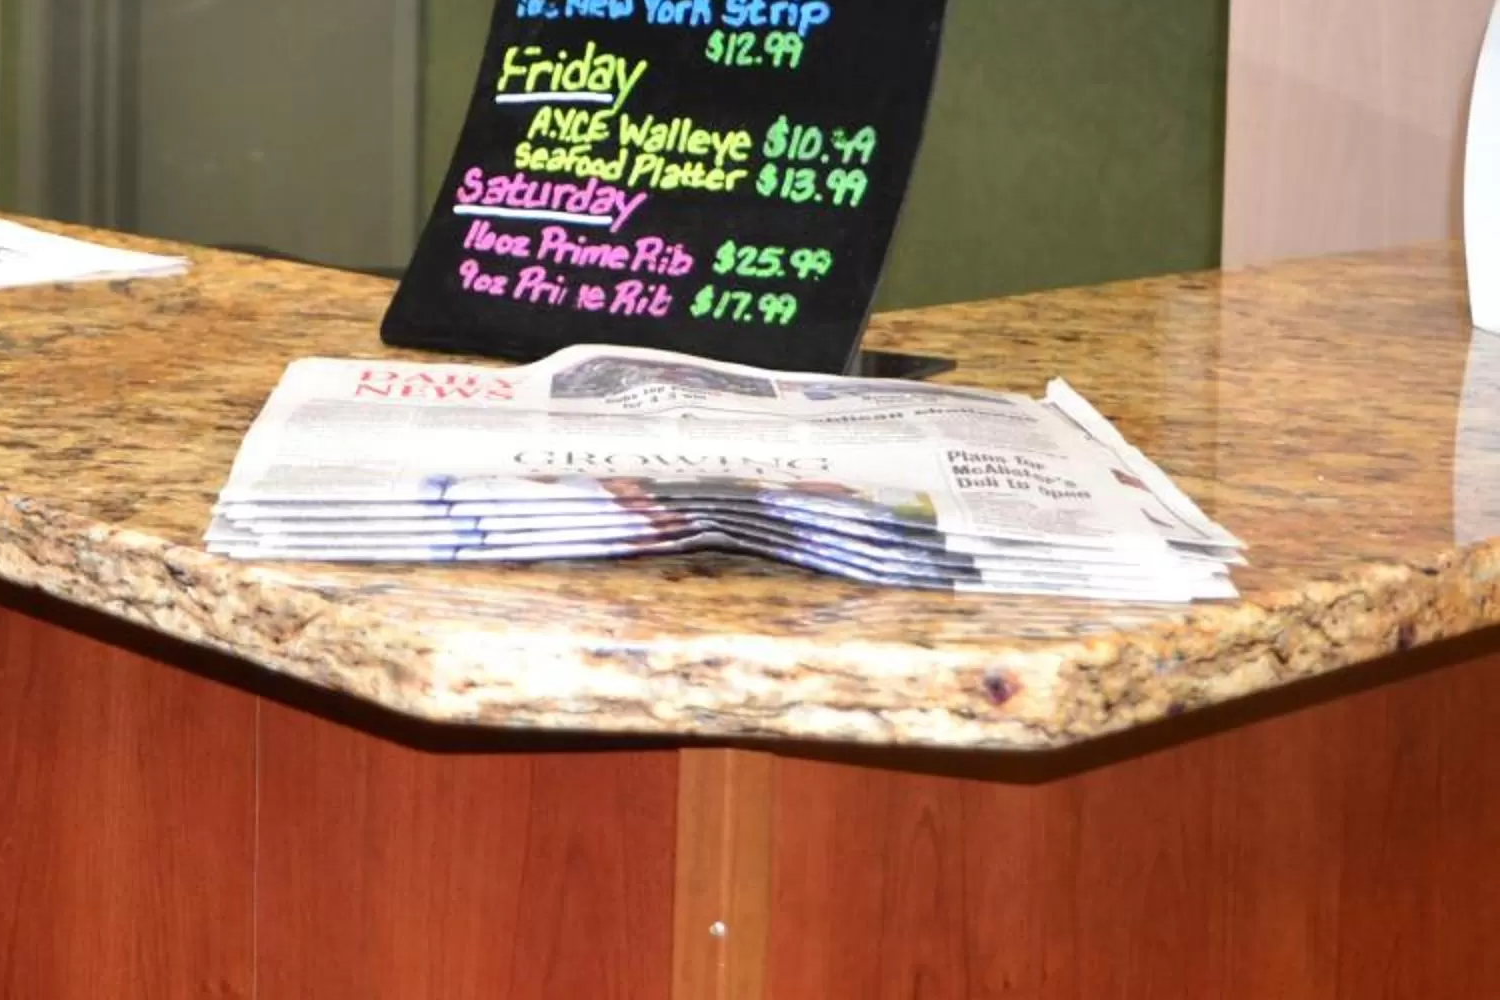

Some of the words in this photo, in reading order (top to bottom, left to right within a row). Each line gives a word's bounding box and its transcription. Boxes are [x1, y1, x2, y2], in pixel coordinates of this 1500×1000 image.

[497, 41, 647, 110] Friday
[704, 31, 803, 68] $12.99
[619, 113, 752, 167] Walleye
[762, 114, 877, 164] $10.99
[456, 168, 648, 233] Saturday
[627, 153, 748, 192] Platter
[755, 162, 868, 207] $13.99
[463, 219, 532, 258] 16oz
[536, 225, 630, 270] Prime
[630, 236, 695, 277] Rib
[712, 240, 833, 281] $25.99
[458, 258, 510, 296] 9oz
[608, 279, 674, 317] Rib
[689, 284, 798, 325] $17.99
[355, 384, 513, 399] NEWS
[513, 450, 829, 468] GROWING
